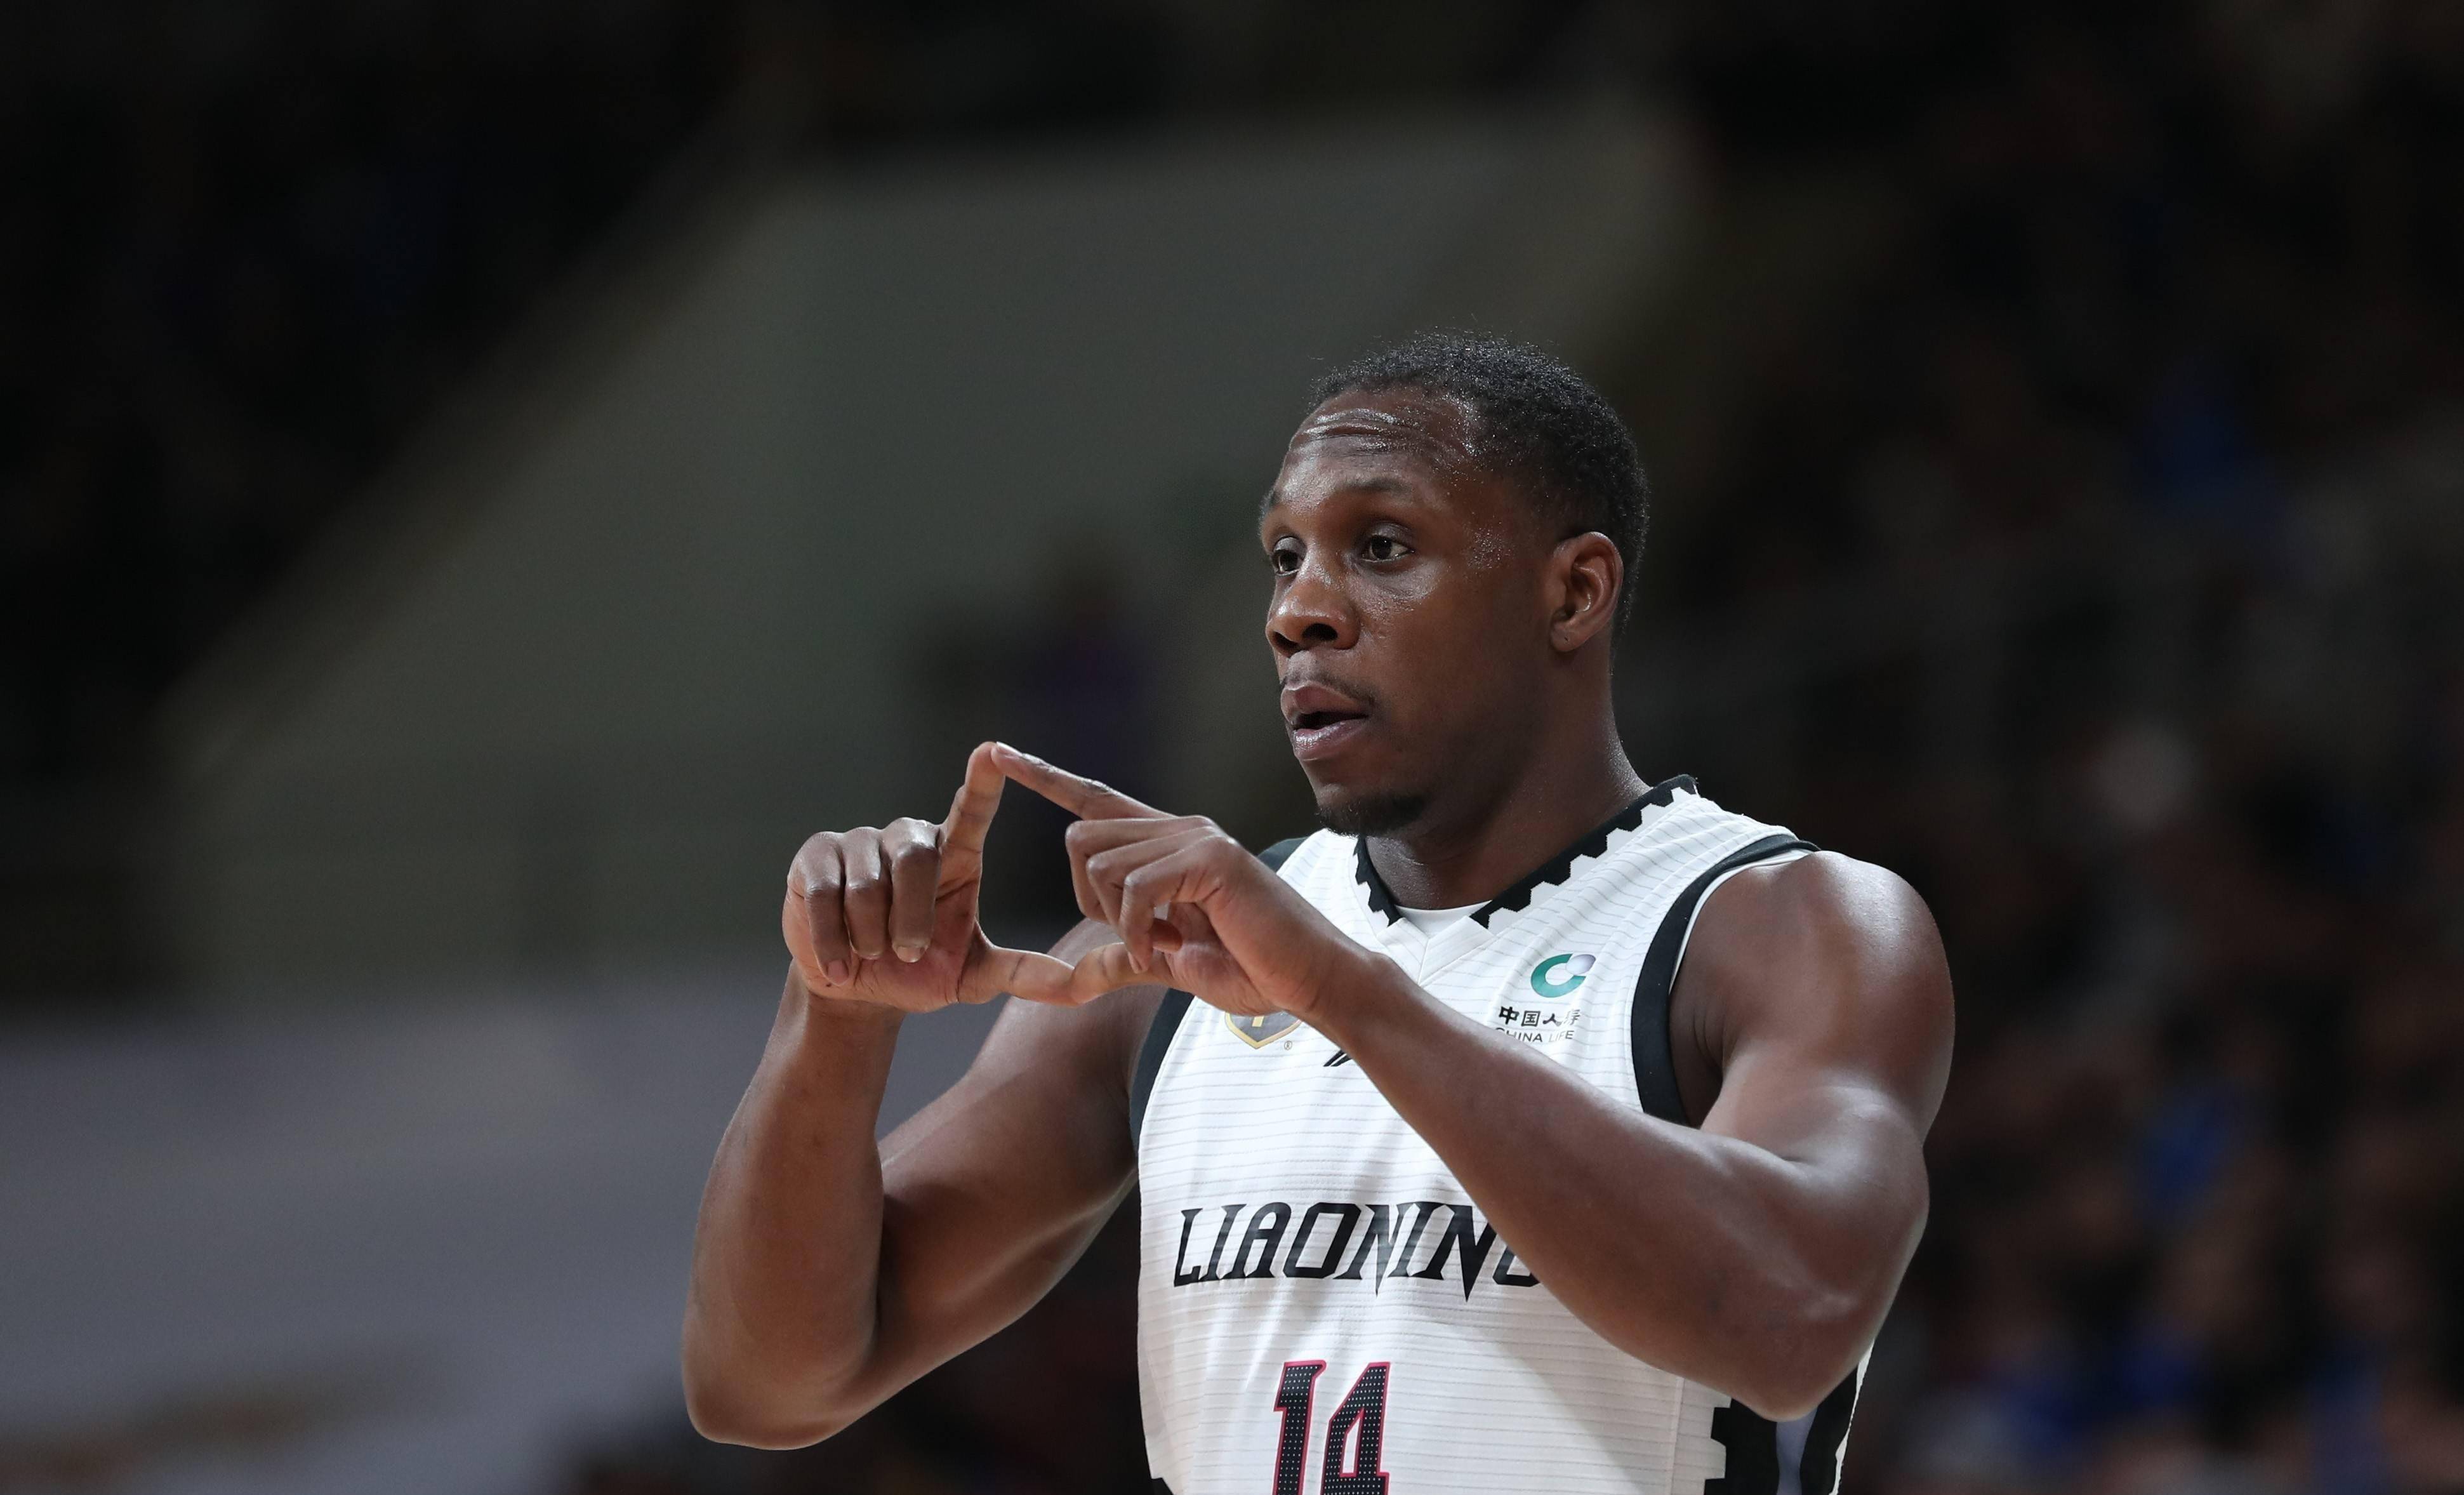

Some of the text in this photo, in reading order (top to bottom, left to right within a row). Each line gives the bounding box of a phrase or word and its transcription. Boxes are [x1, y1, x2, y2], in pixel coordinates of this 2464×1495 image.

[1495, 1027, 1575, 1042] HINA LIFE
[1271, 1360, 1390, 1495] 14
